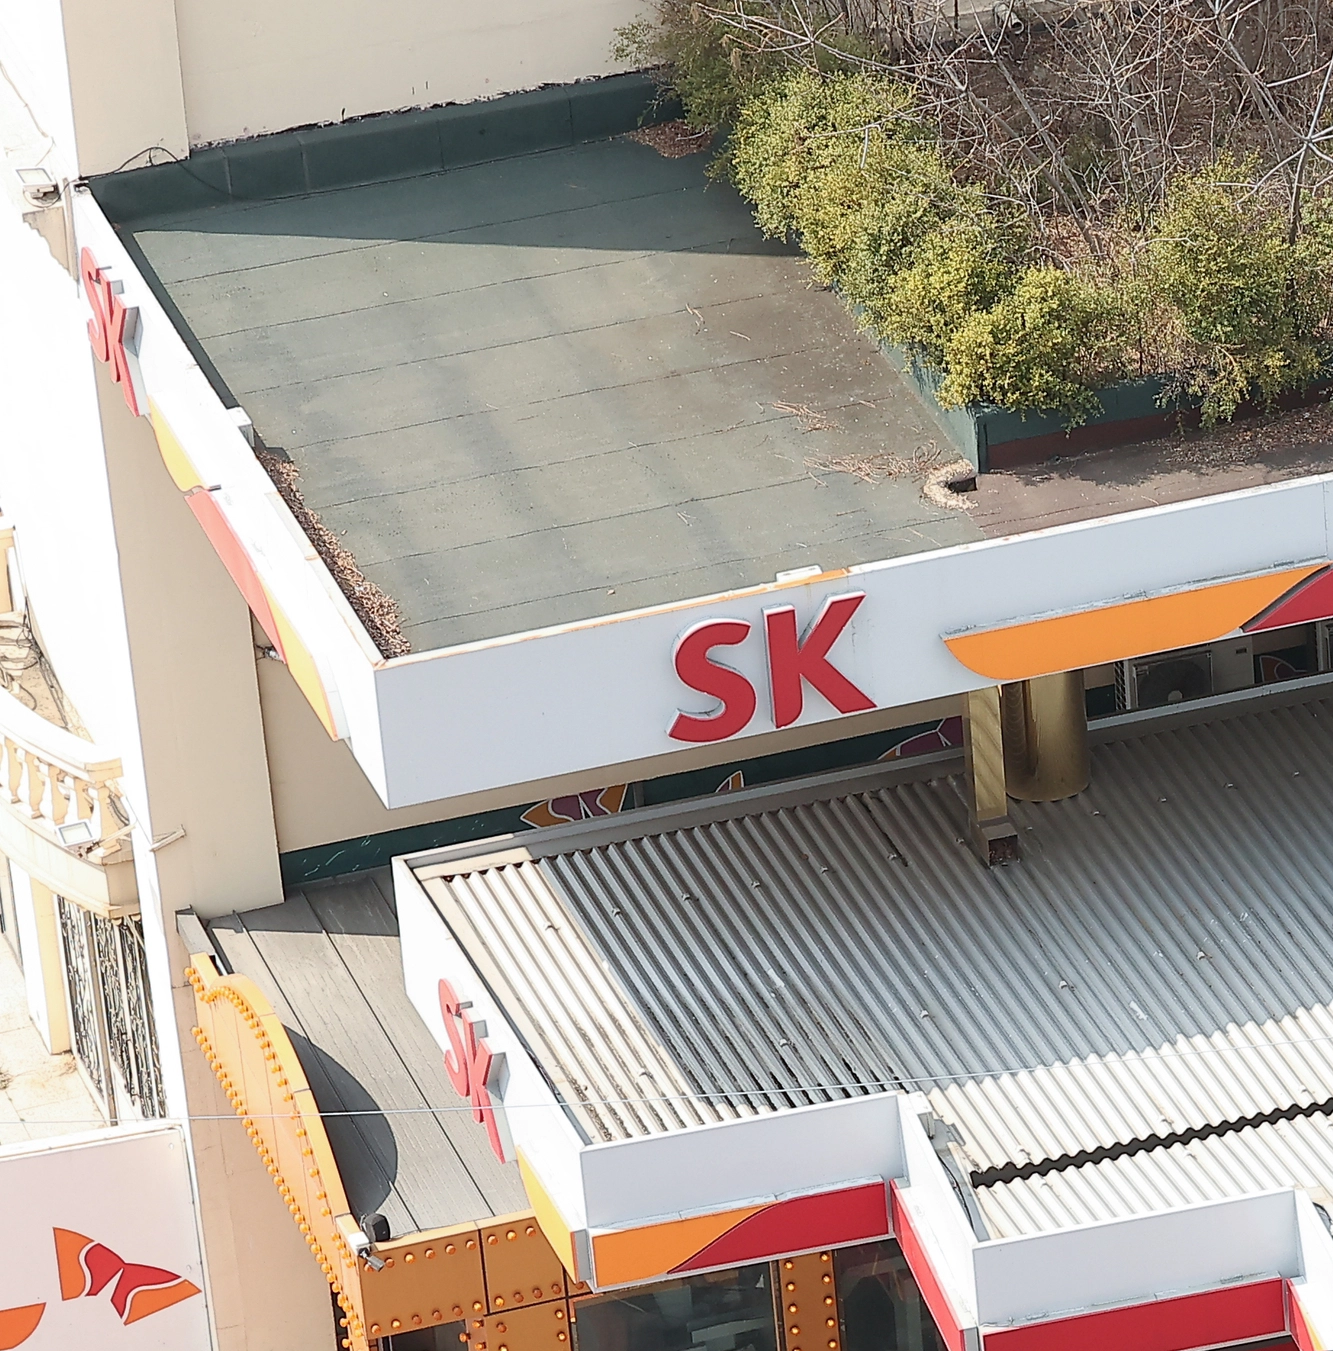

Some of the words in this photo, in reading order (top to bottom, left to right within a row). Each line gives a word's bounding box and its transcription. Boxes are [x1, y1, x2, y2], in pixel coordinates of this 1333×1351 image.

[81, 246, 142, 417] SK
[667, 590, 878, 743] SK
[438, 977, 508, 1164] SK
